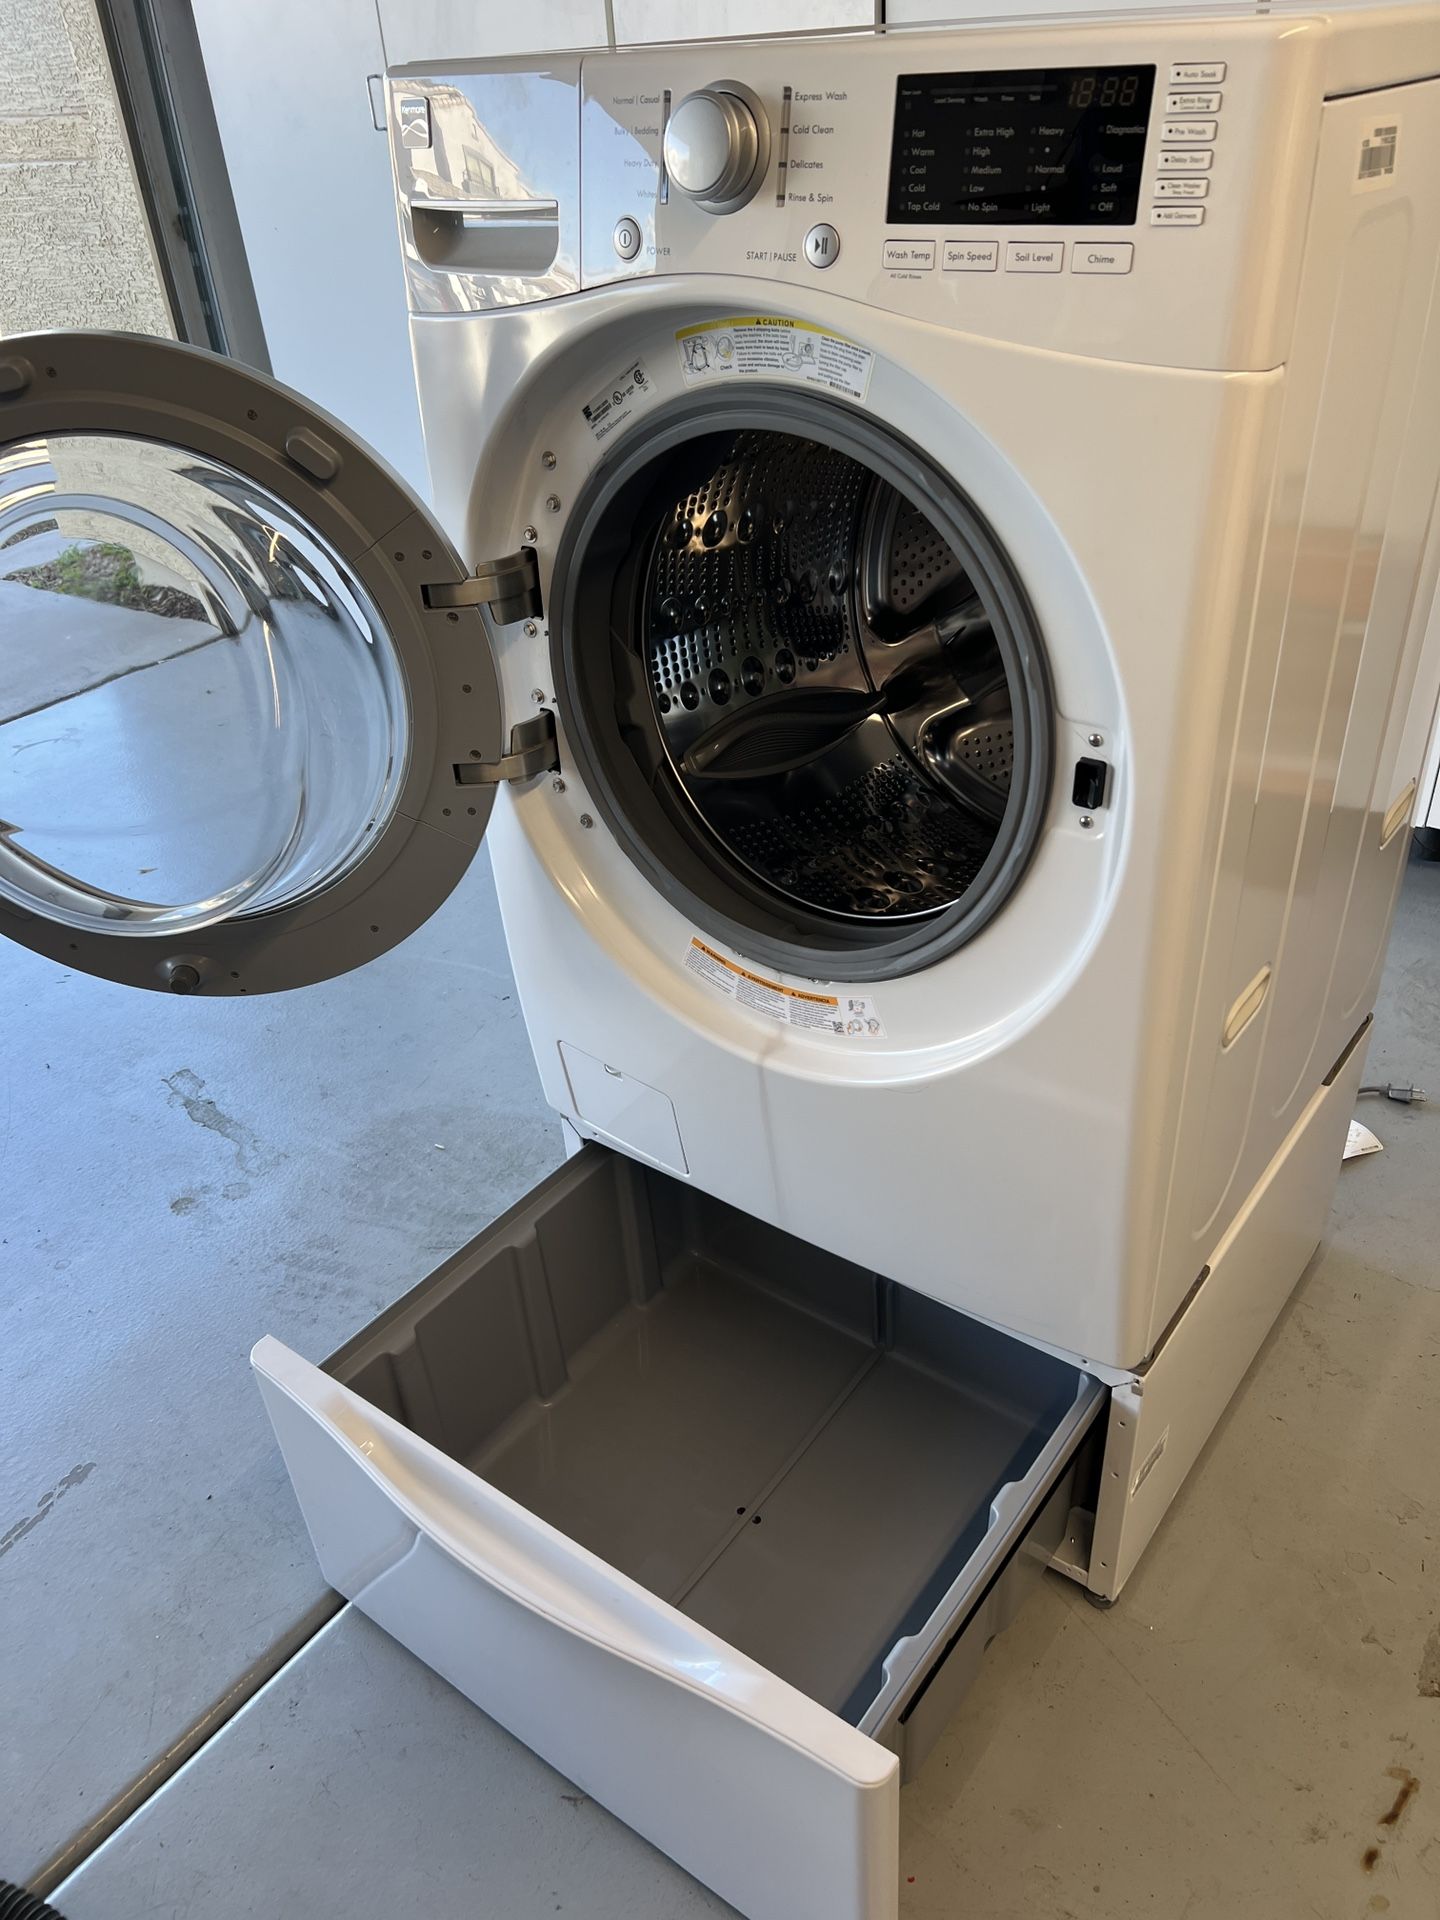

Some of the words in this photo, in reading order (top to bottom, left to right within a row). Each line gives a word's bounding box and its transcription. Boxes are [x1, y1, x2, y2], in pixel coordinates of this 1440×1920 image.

[640, 94, 660, 104] Casual
[795, 92, 822, 102] Express
[826, 92, 848, 100] Wash
[634, 126, 658, 136] Bedding
[792, 124, 810, 134] Cold
[812, 124, 834, 134] Clean
[974, 128, 994, 136] Extra
[996, 128, 1014, 138] High
[1038, 127, 1064, 136] Heavy
[912, 148, 935, 156] Warm
[972, 147, 990, 157] High
[790, 160, 824, 168] Delicates
[1034, 164, 1066, 173] Normal
[1102, 164, 1123, 173] Loud
[910, 166, 926, 174] Cool
[971, 166, 1002, 174] Medium
[908, 184, 926, 192] Cold
[969, 184, 984, 192] Low
[1100, 183, 1118, 192] Soft
[788, 193, 806, 202] Rinse
[809, 193, 814, 202] &
[817, 193, 834, 204] Spin
[908, 202, 921, 212] Tap
[923, 202, 940, 210] Cold
[968, 202, 980, 210] No
[982, 202, 998, 212] Spin
[1032, 203, 1050, 213] Light
[1098, 202, 1114, 211] Off
[646, 246, 671, 256] POWER
[887, 250, 908, 259] Wash
[910, 250, 930, 260] Temp
[746, 251, 768, 260] START
[774, 252, 797, 262] PAUSE
[948, 251, 964, 262] Spin
[967, 252, 992, 262] Speed
[1015, 252, 1030, 262] Soil
[1032, 252, 1054, 262] Level
[1088, 254, 1115, 264] Chime
[762, 319, 794, 328] CAUTION
